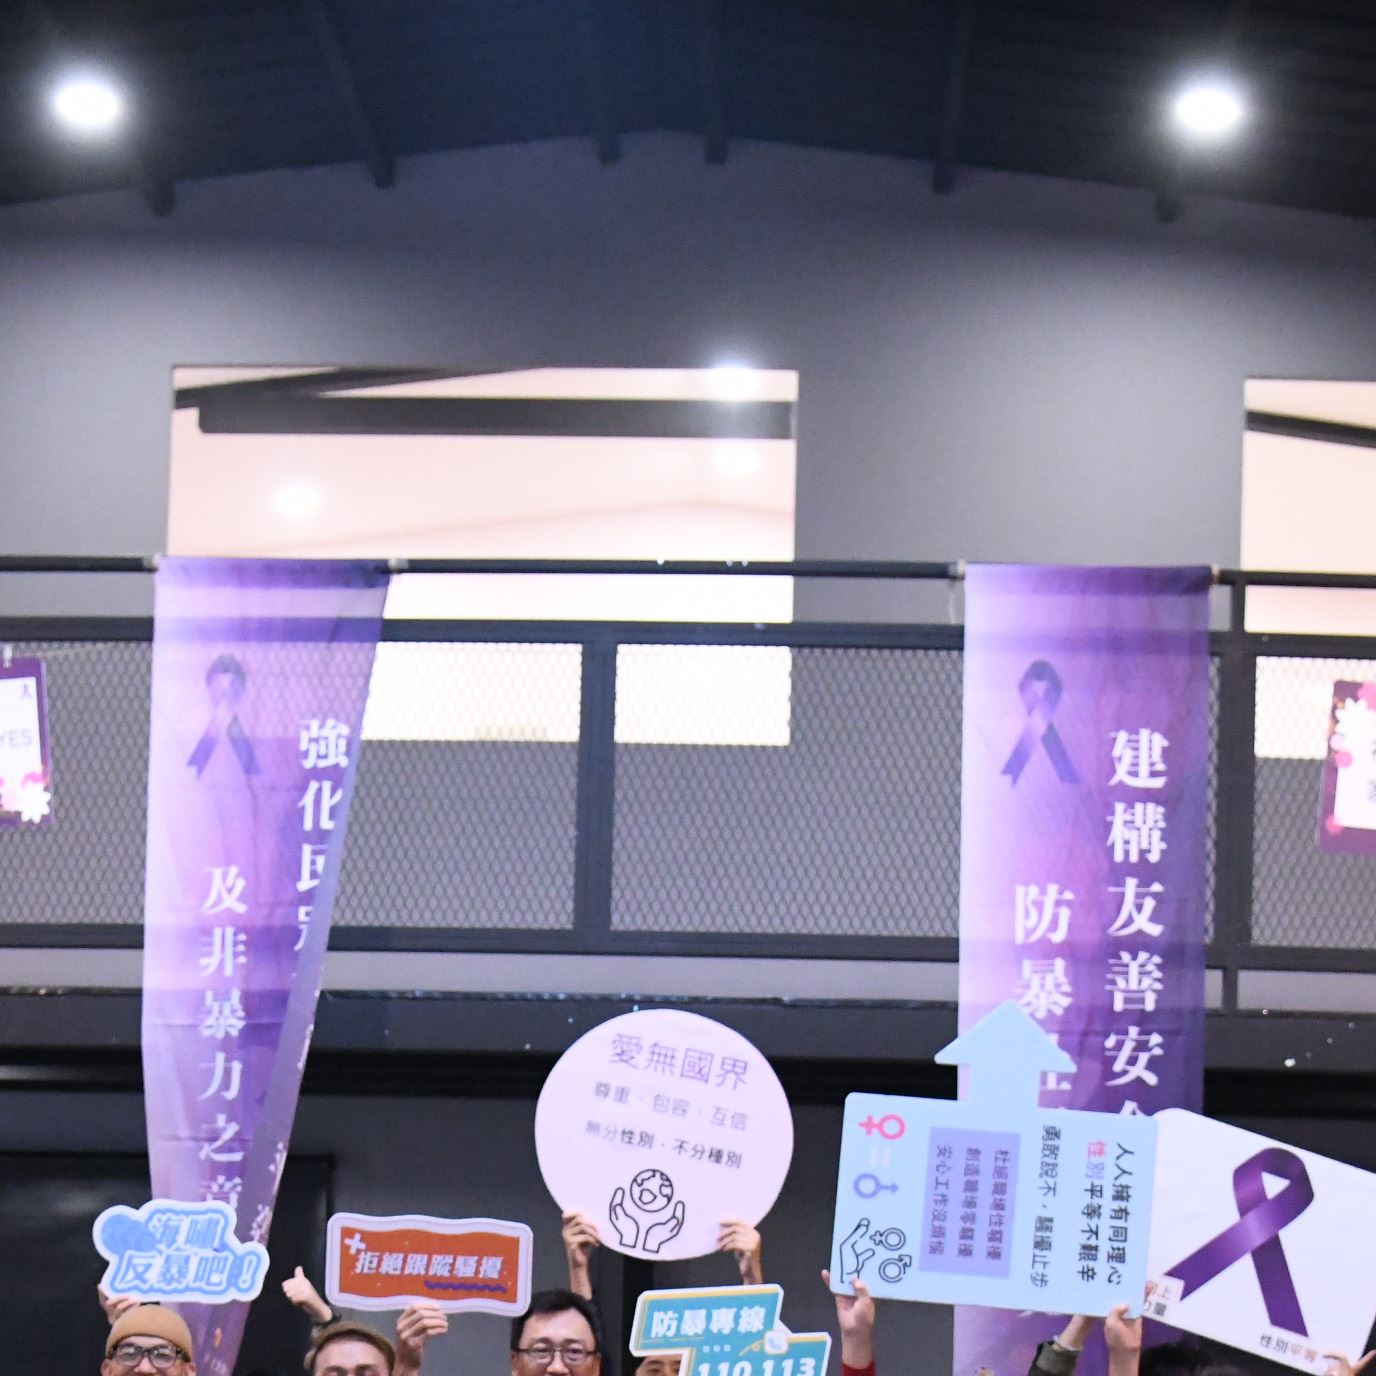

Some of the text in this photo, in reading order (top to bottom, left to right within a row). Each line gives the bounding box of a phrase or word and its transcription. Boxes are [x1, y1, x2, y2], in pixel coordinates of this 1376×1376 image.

[608, 1033, 749, 1091] 愛無國界
[1106, 1141, 1135, 1286] 人人擁有同理心
[354, 1251, 504, 1279] 拒絕跟蹤騷擾
[650, 1306, 766, 1338] 防暴專線
